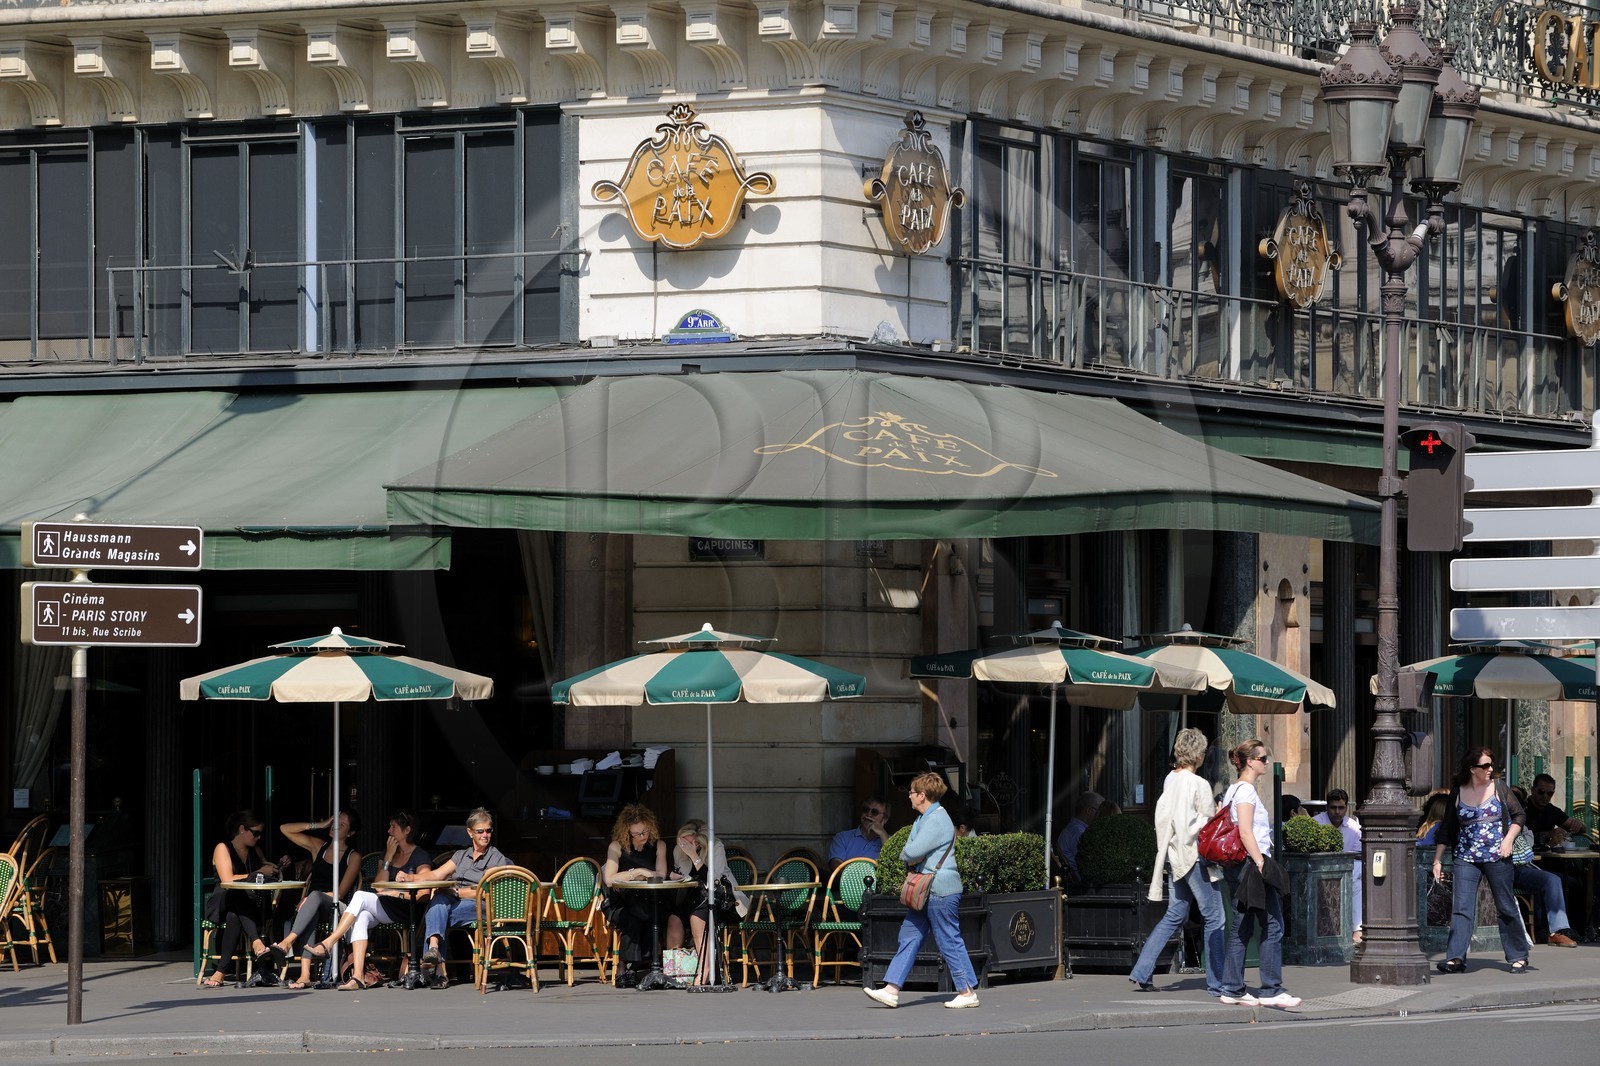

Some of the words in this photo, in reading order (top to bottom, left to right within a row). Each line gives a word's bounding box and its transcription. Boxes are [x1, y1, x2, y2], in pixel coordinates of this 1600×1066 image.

[652, 196, 713, 223] PAIX
[854, 445, 971, 468] PAIX
[63, 530, 132, 544] Haussmann
[697, 540, 755, 551] CAPUCINES
[107, 548, 160, 563] Magasins
[63, 592, 105, 605] Cinéma
[71, 609, 106, 622] PARIS
[110, 610, 148, 622] STORY
[62, 626, 70, 636] 11
[72, 626, 90, 637] bis,
[92, 627, 110, 636] Rue
[113, 627, 142, 637] Scribe
[1091, 670, 1107, 679] CAFÉ
[1118, 673, 1132, 681] PAIX
[394, 684, 409, 694] CAFÉ
[418, 685, 432, 693] PAIX
[671, 688, 689, 698] CAFÉ
[700, 690, 716, 698] PAIX
